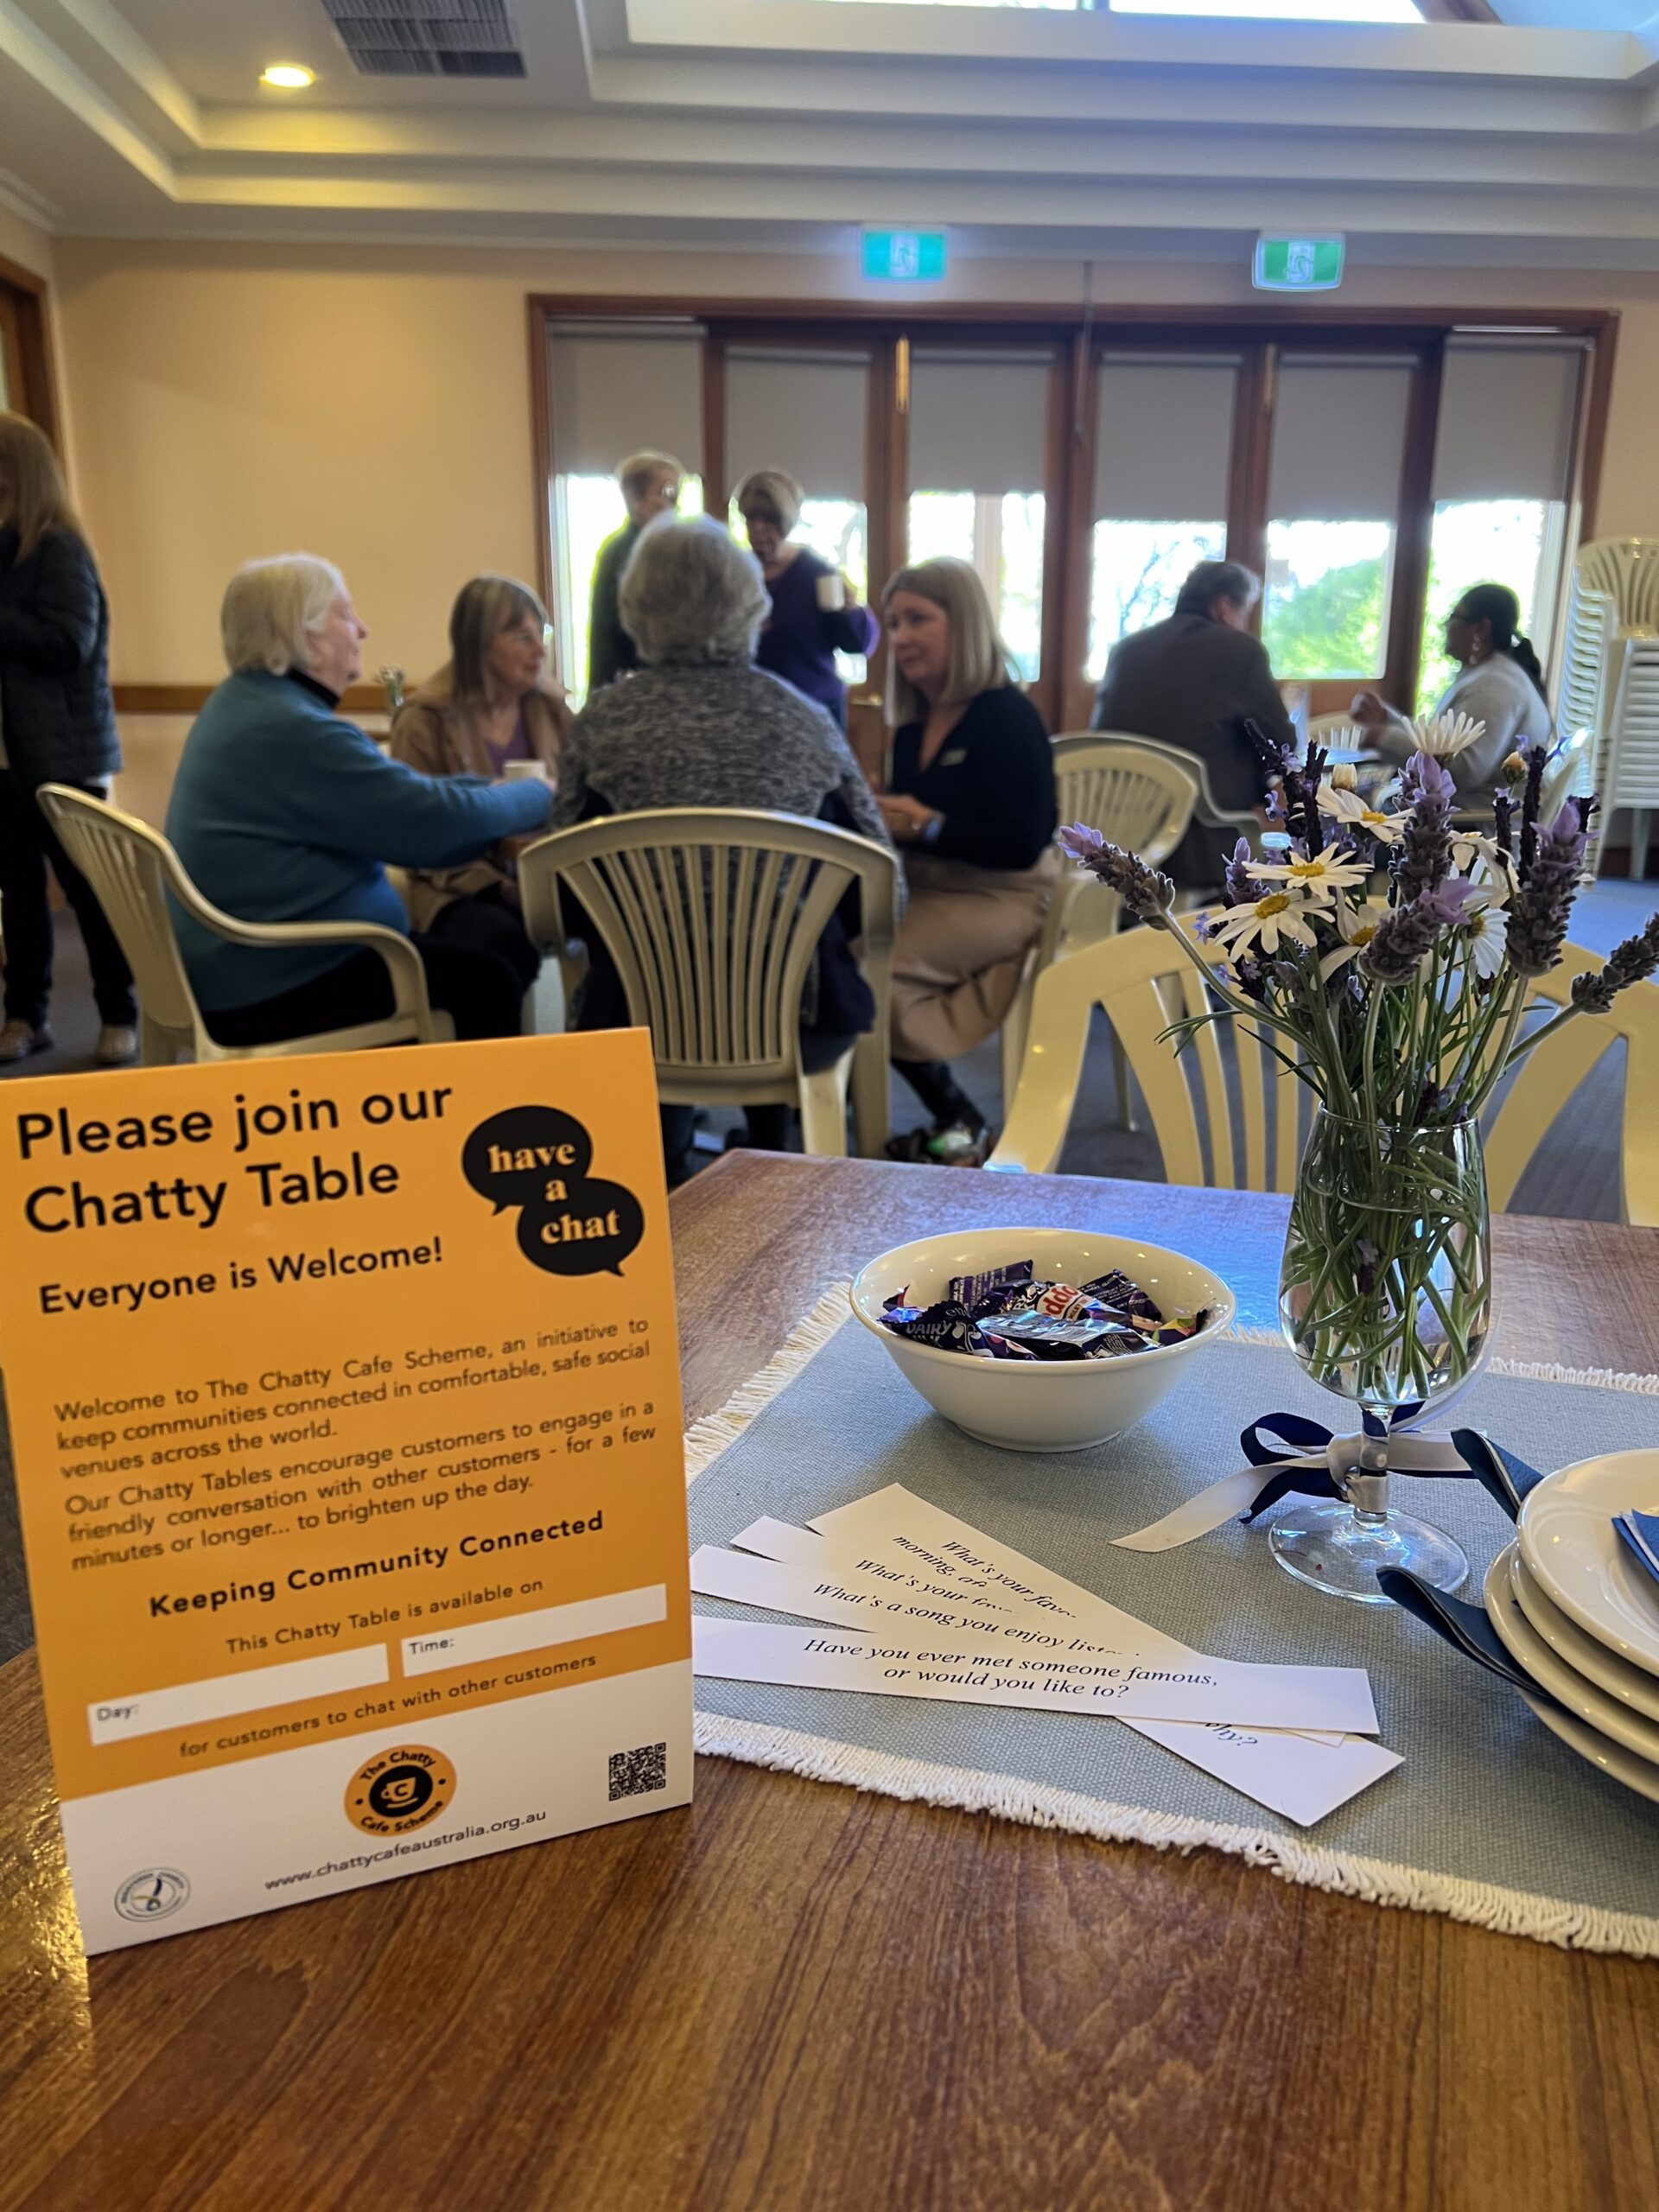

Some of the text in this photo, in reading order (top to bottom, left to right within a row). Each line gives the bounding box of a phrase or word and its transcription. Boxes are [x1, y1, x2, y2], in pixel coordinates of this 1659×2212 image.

[17, 1087, 453, 1160] Please join our
[487, 1142, 576, 1173] have
[24, 1152, 399, 1233] Chatty Table
[544, 1179, 569, 1202] a
[540, 1208, 621, 1245] chat
[39, 1236, 442, 1314] Everyone is Welcome!
[906, 1320, 951, 1335] DAIRY
[54, 1319, 649, 1422] Welcome to The Chatty Cafe Scheme, an initiative to
[56, 1338, 650, 1451] keep communities connected in comfortable, safe social
[60, 1417, 338, 1479] venues across the world.
[64, 1401, 654, 1516] Our Chatty Tables encourage customers to engage in a
[68, 1512, 155, 1543] friendly
[167, 1489, 307, 1527] conversation
[317, 1475, 362, 1499] with
[372, 1468, 429, 1491] other
[437, 1447, 541, 1478] customers
[566, 1435, 594, 1454] for
[601, 1434, 613, 1449] a
[622, 1426, 657, 1445] few
[72, 1473, 533, 1571] minutes or longer... to brighten up the day.
[149, 1510, 603, 1618] Keeping Community Connected
[855, 1560, 969, 1600] What's your
[893, 1536, 954, 1577] morning,
[940, 1541, 996, 1574] What's
[988, 1573, 1034, 1595] your
[226, 1580, 543, 1655] This Chatty Table is available on
[409, 1637, 454, 1655] Time:
[813, 1584, 883, 1607] What's
[887, 1602, 902, 1612] a
[905, 1605, 957, 1627] song
[955, 1617, 999, 1633] you
[1004, 1626, 1064, 1649] enjoy
[804, 1639, 1217, 1686] Have you ever met someone famous,
[883, 1669, 1129, 1698] or would you like to?
[97, 1703, 140, 1721] Day:
[179, 1656, 596, 1758] for customers to chat with other customers
[359, 1751, 437, 1781] The Chatty
[360, 1801, 443, 1833] Cafe Scheme
[264, 1811, 546, 1890] www.chattycafeaustralia.org.au
